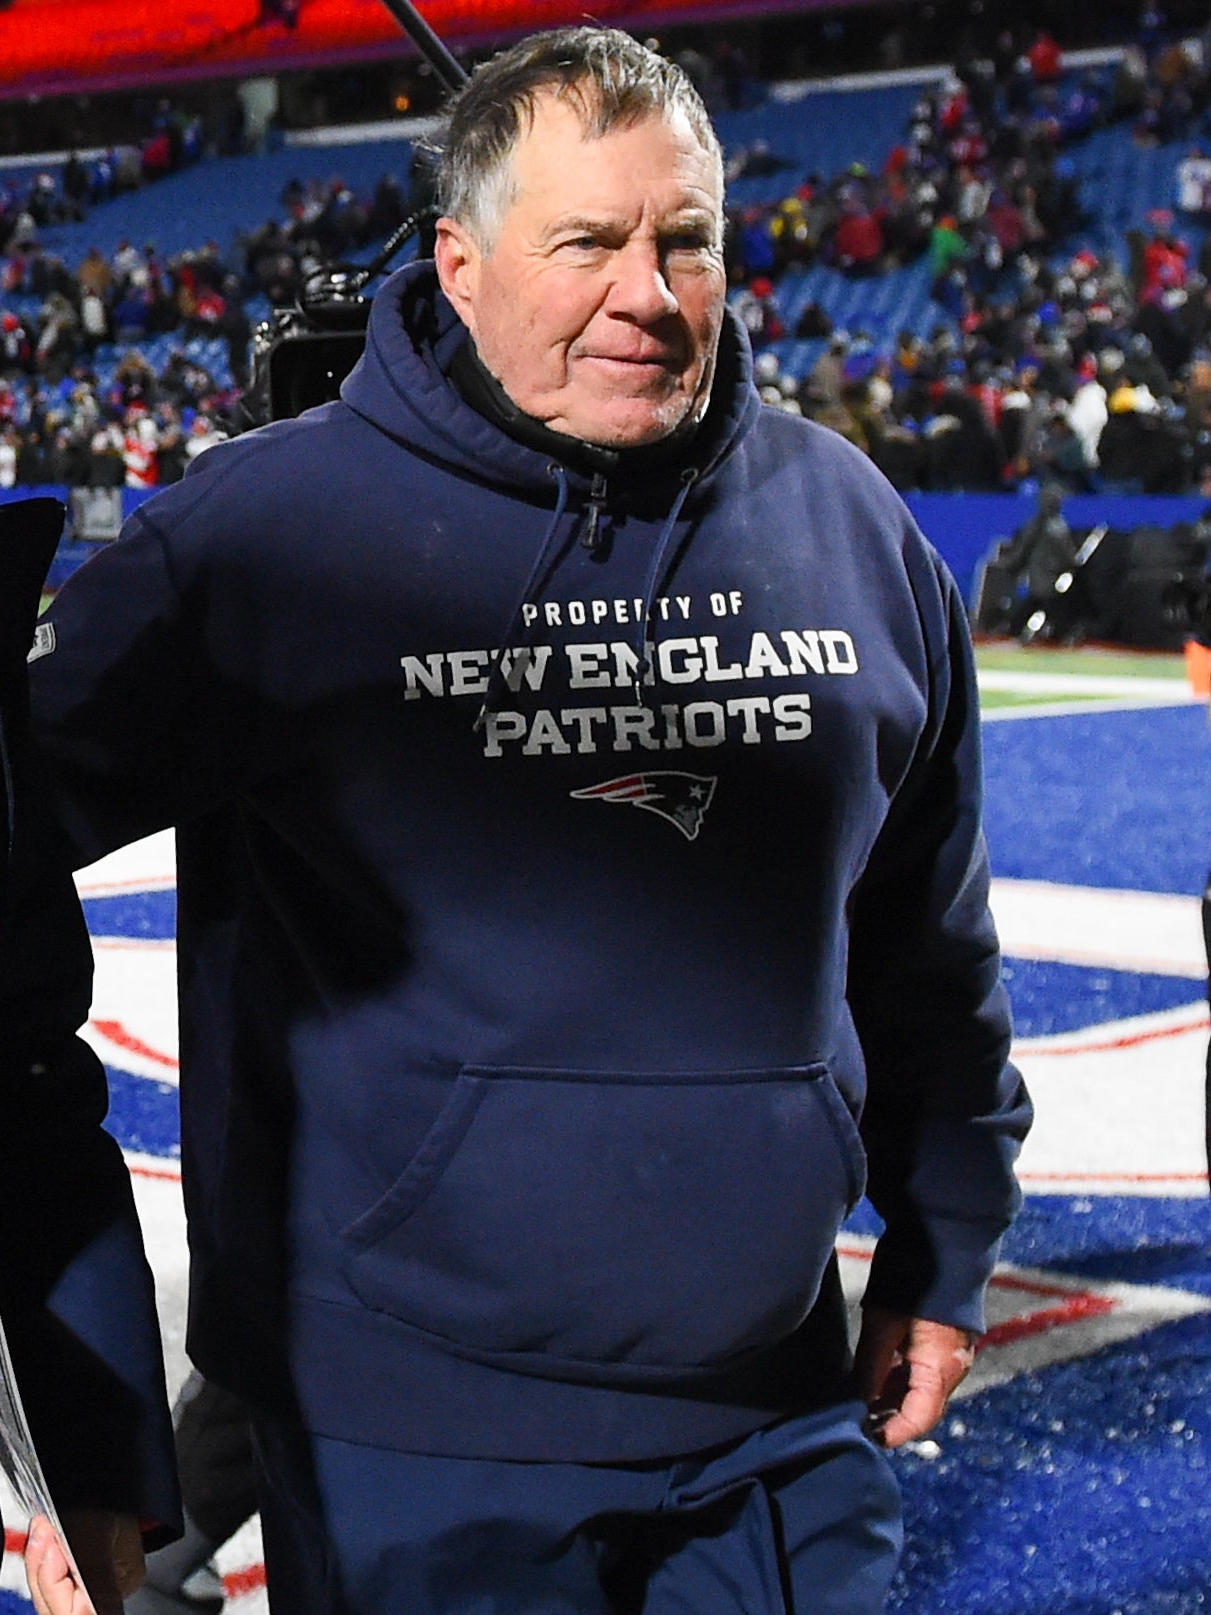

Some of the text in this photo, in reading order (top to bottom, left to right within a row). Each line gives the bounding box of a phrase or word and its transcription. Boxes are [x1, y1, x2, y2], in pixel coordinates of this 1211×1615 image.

[522, 591, 743, 628] PROPERTY OF
[400, 630, 859, 700] NEW ENGLAND
[483, 694, 813, 758] PATRIOTS
